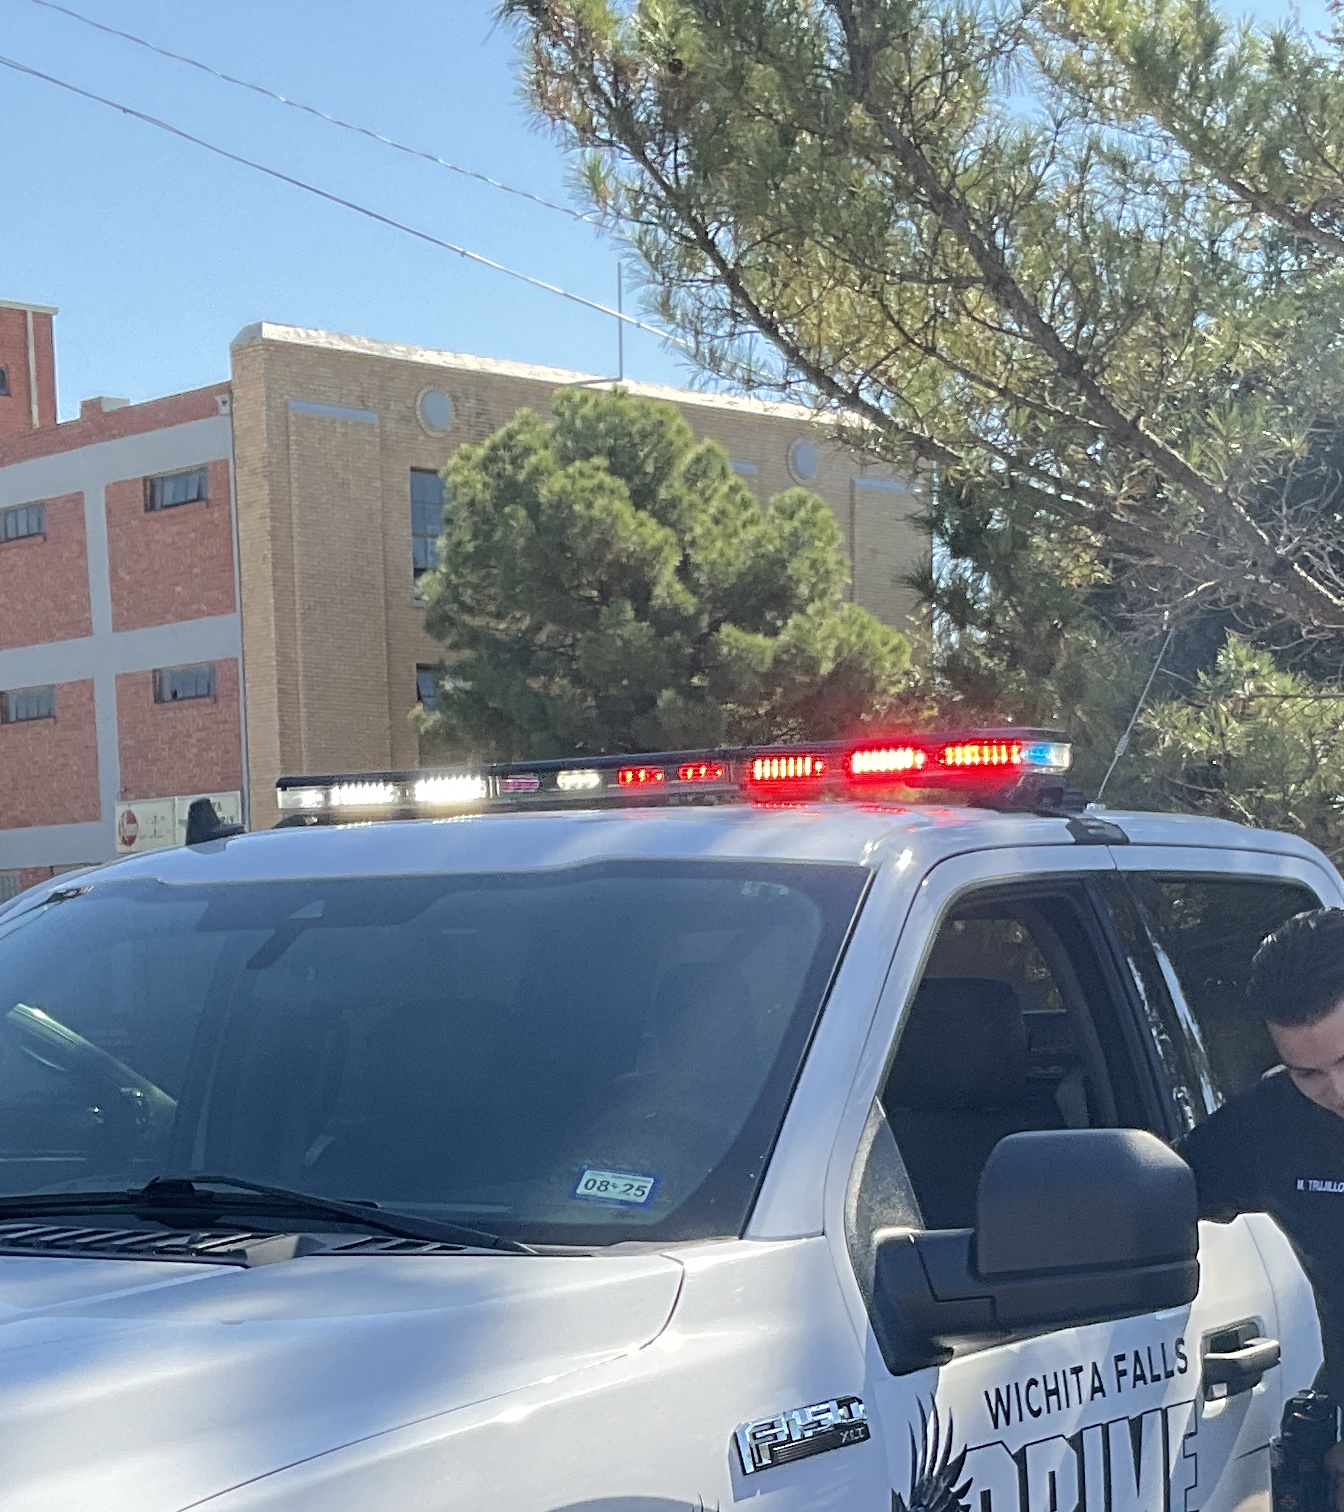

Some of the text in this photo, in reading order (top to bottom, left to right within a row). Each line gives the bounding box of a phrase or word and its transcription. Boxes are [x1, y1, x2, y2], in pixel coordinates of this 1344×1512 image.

[583, 1178, 649, 1198] 08 25
[983, 1337, 1189, 1430] WICHITA FALLS
